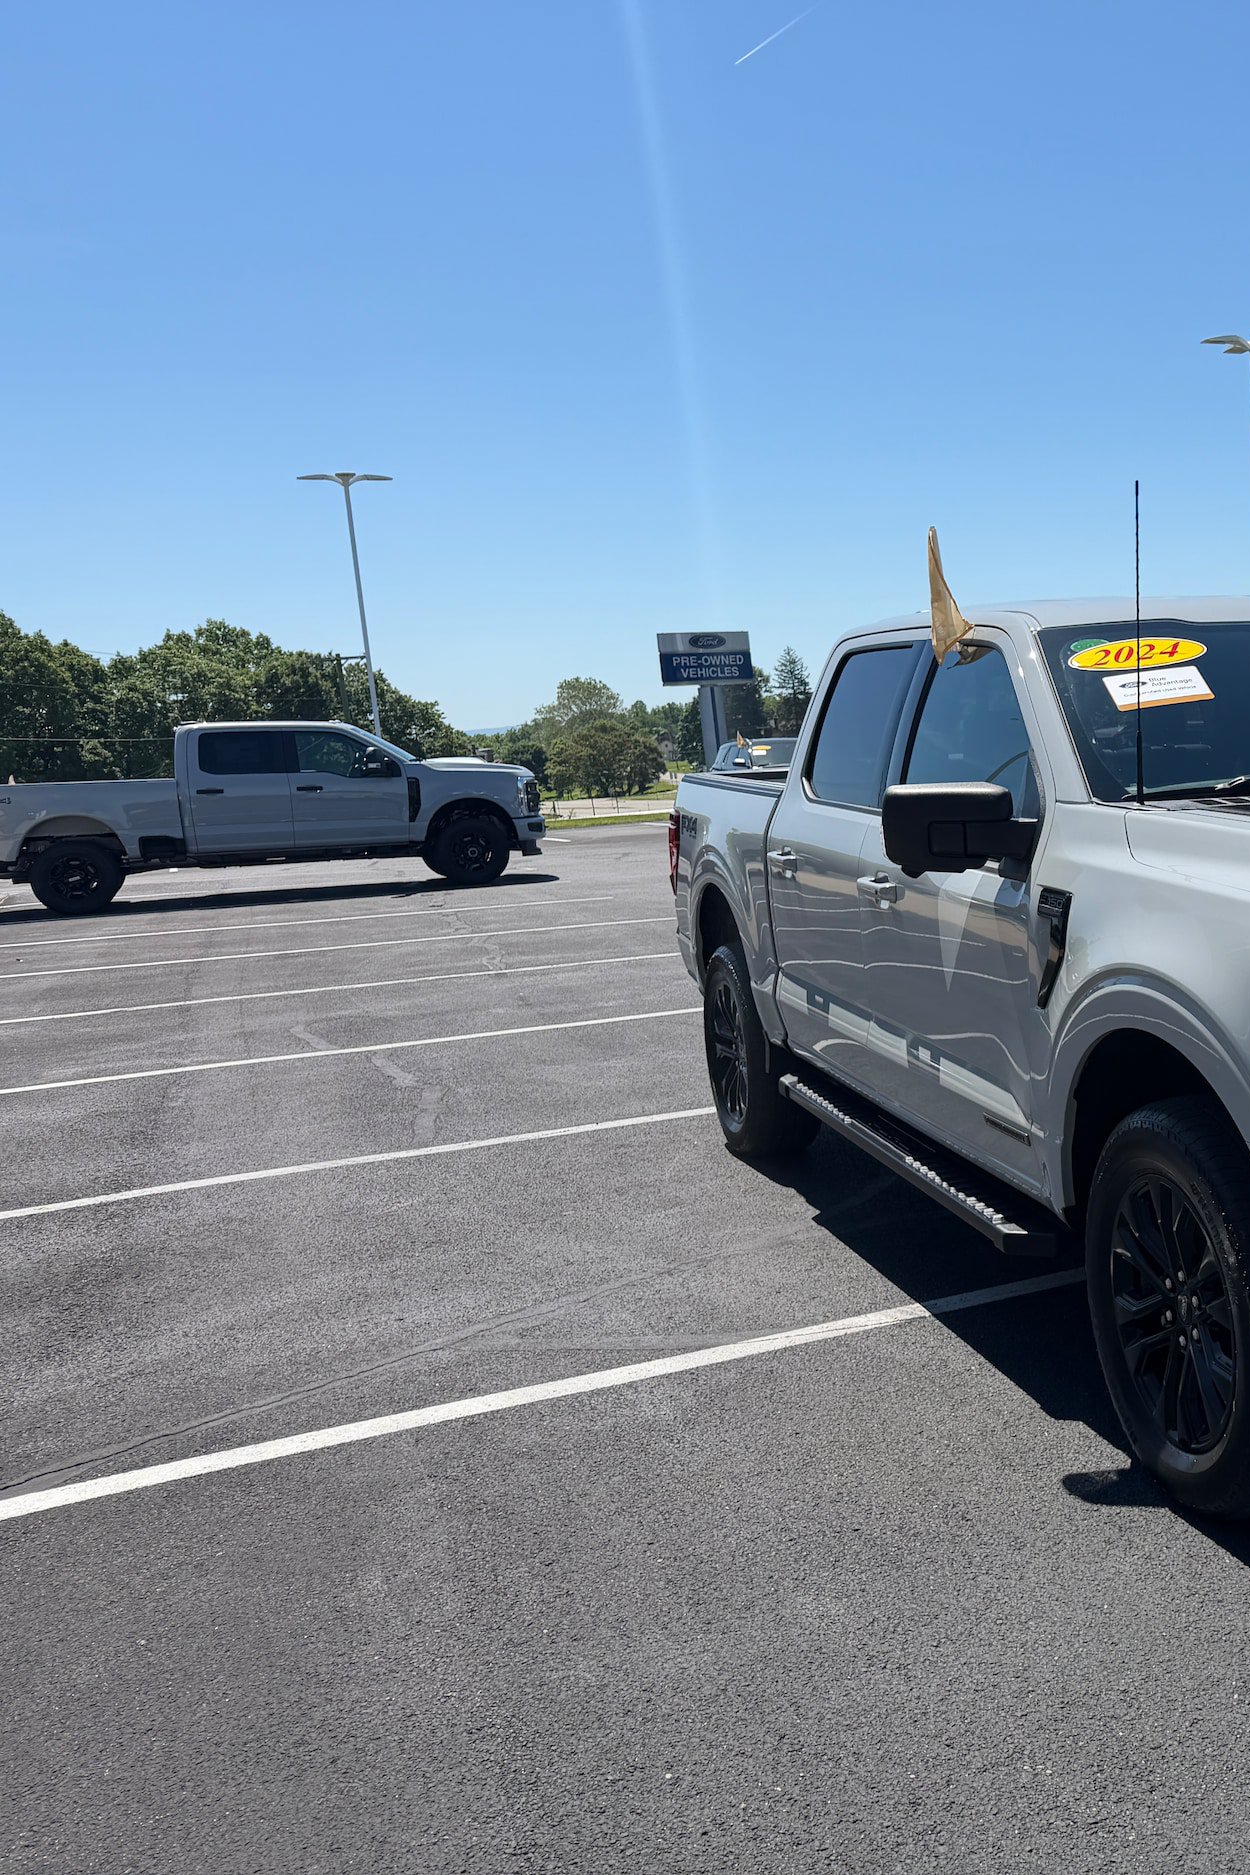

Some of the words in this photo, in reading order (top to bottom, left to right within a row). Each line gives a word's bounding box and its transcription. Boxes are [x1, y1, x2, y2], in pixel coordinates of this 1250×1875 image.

[1094, 641, 1180, 666] 2024
[672, 654, 744, 667] PRE-OWNED
[680, 666, 740, 678] VEHICLES
